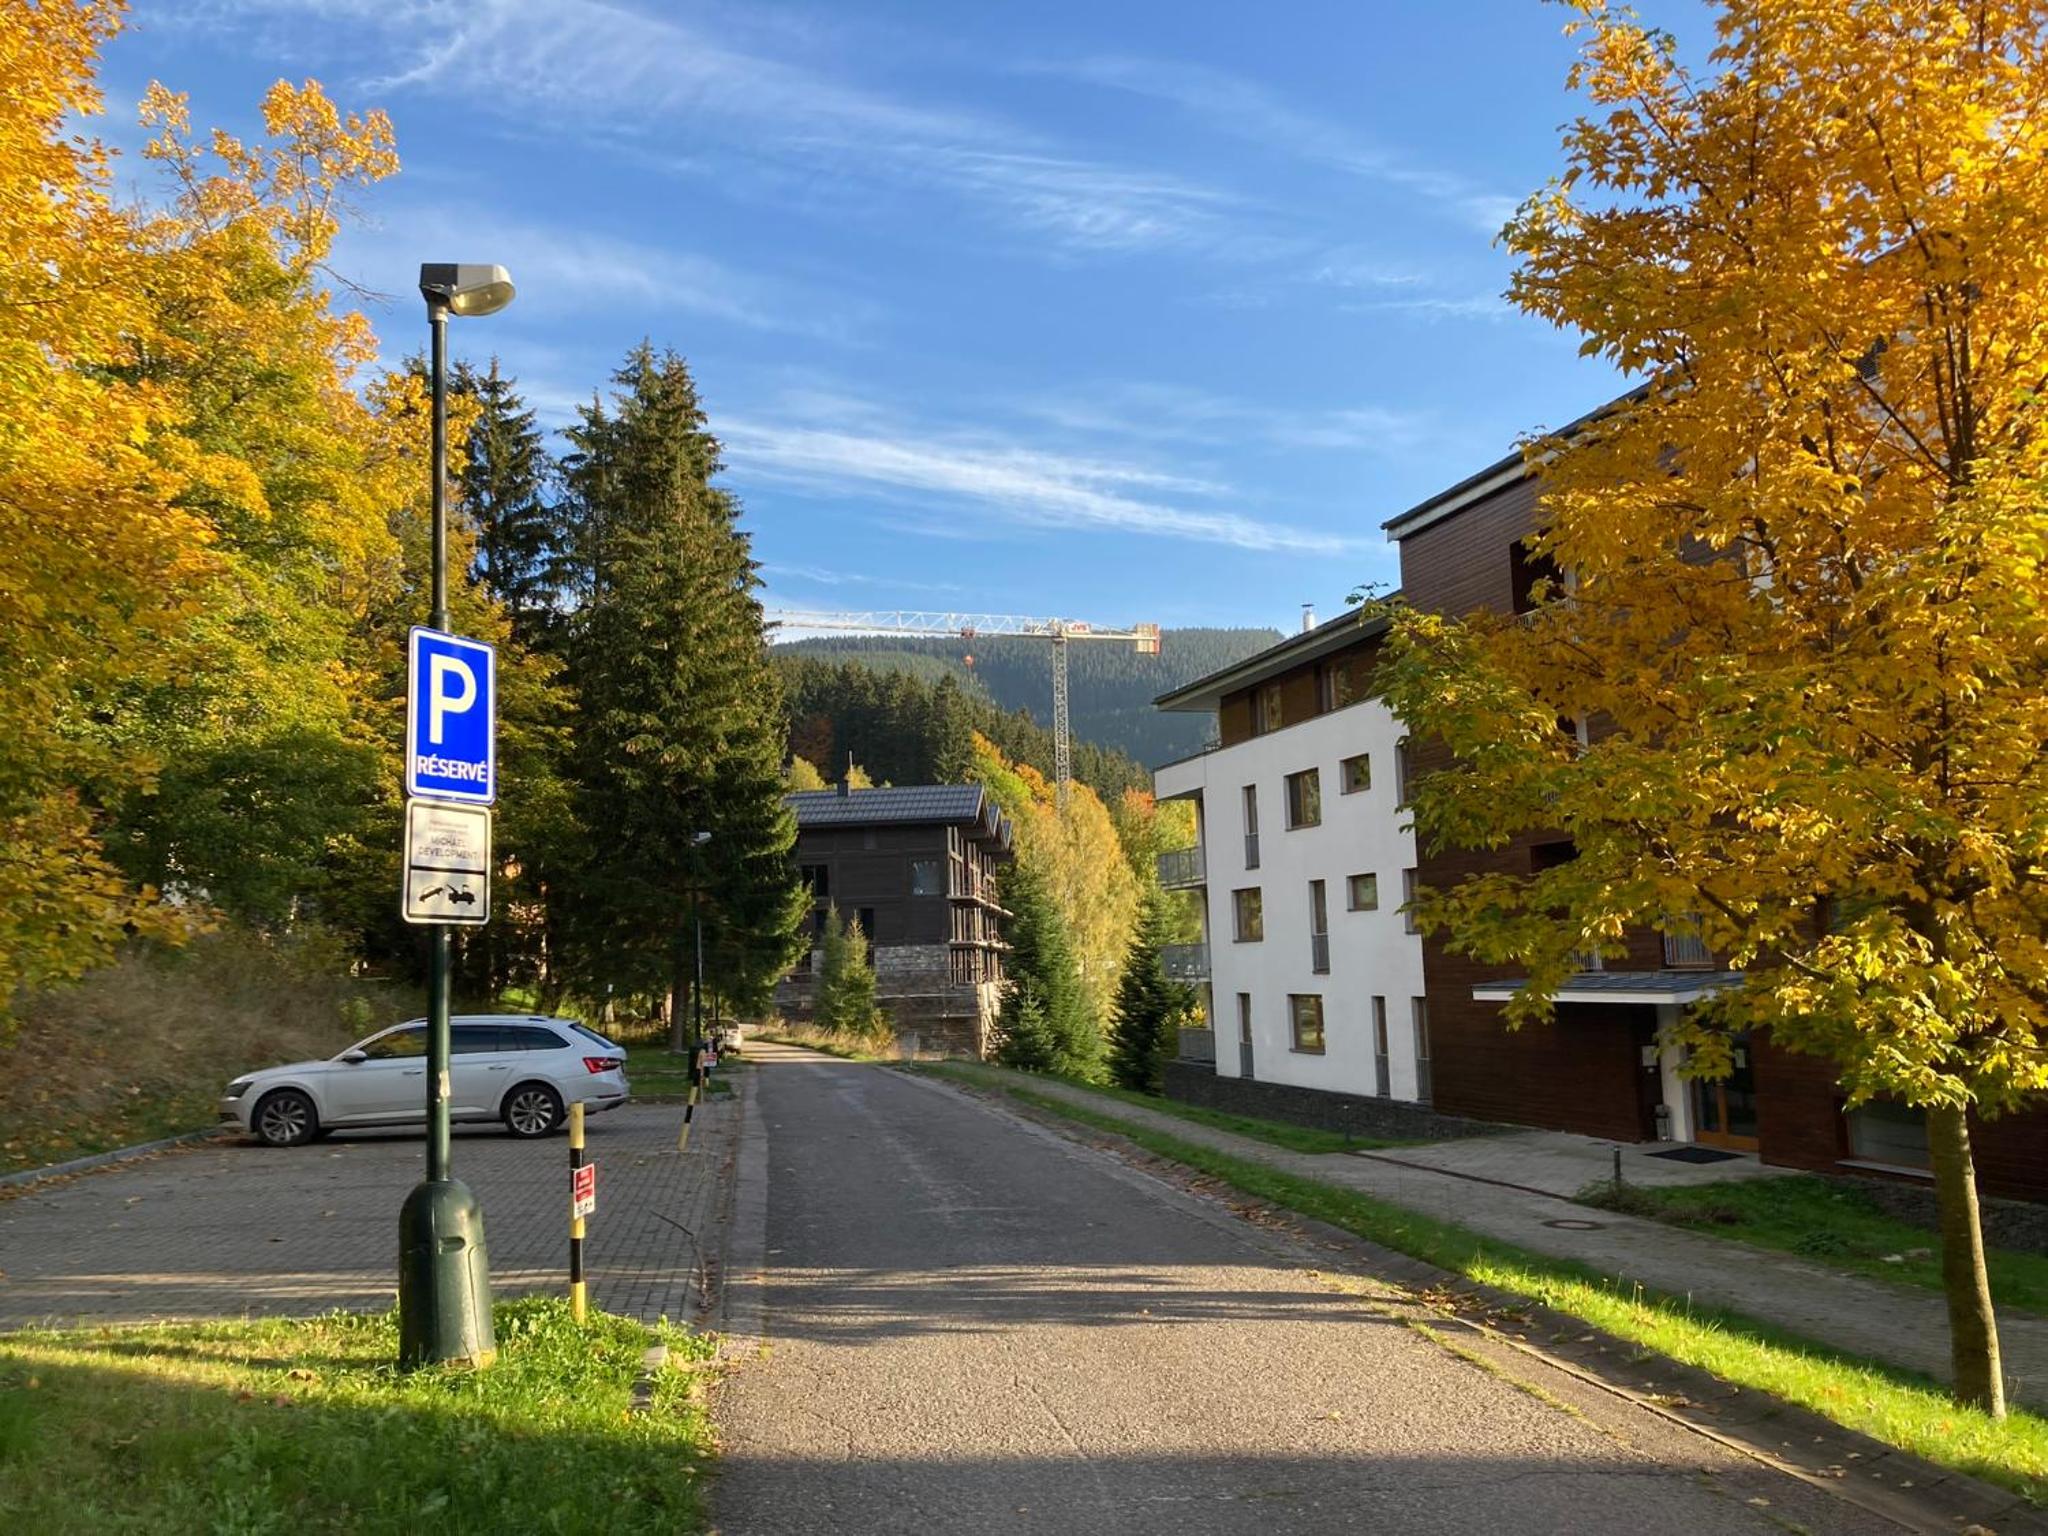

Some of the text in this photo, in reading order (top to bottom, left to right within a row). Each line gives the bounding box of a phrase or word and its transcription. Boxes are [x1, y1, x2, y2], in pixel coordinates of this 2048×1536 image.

[430, 653, 477, 744] P
[417, 753, 487, 783] RÉSERVÉ
[418, 846, 478, 860] DEVELOPMENT
